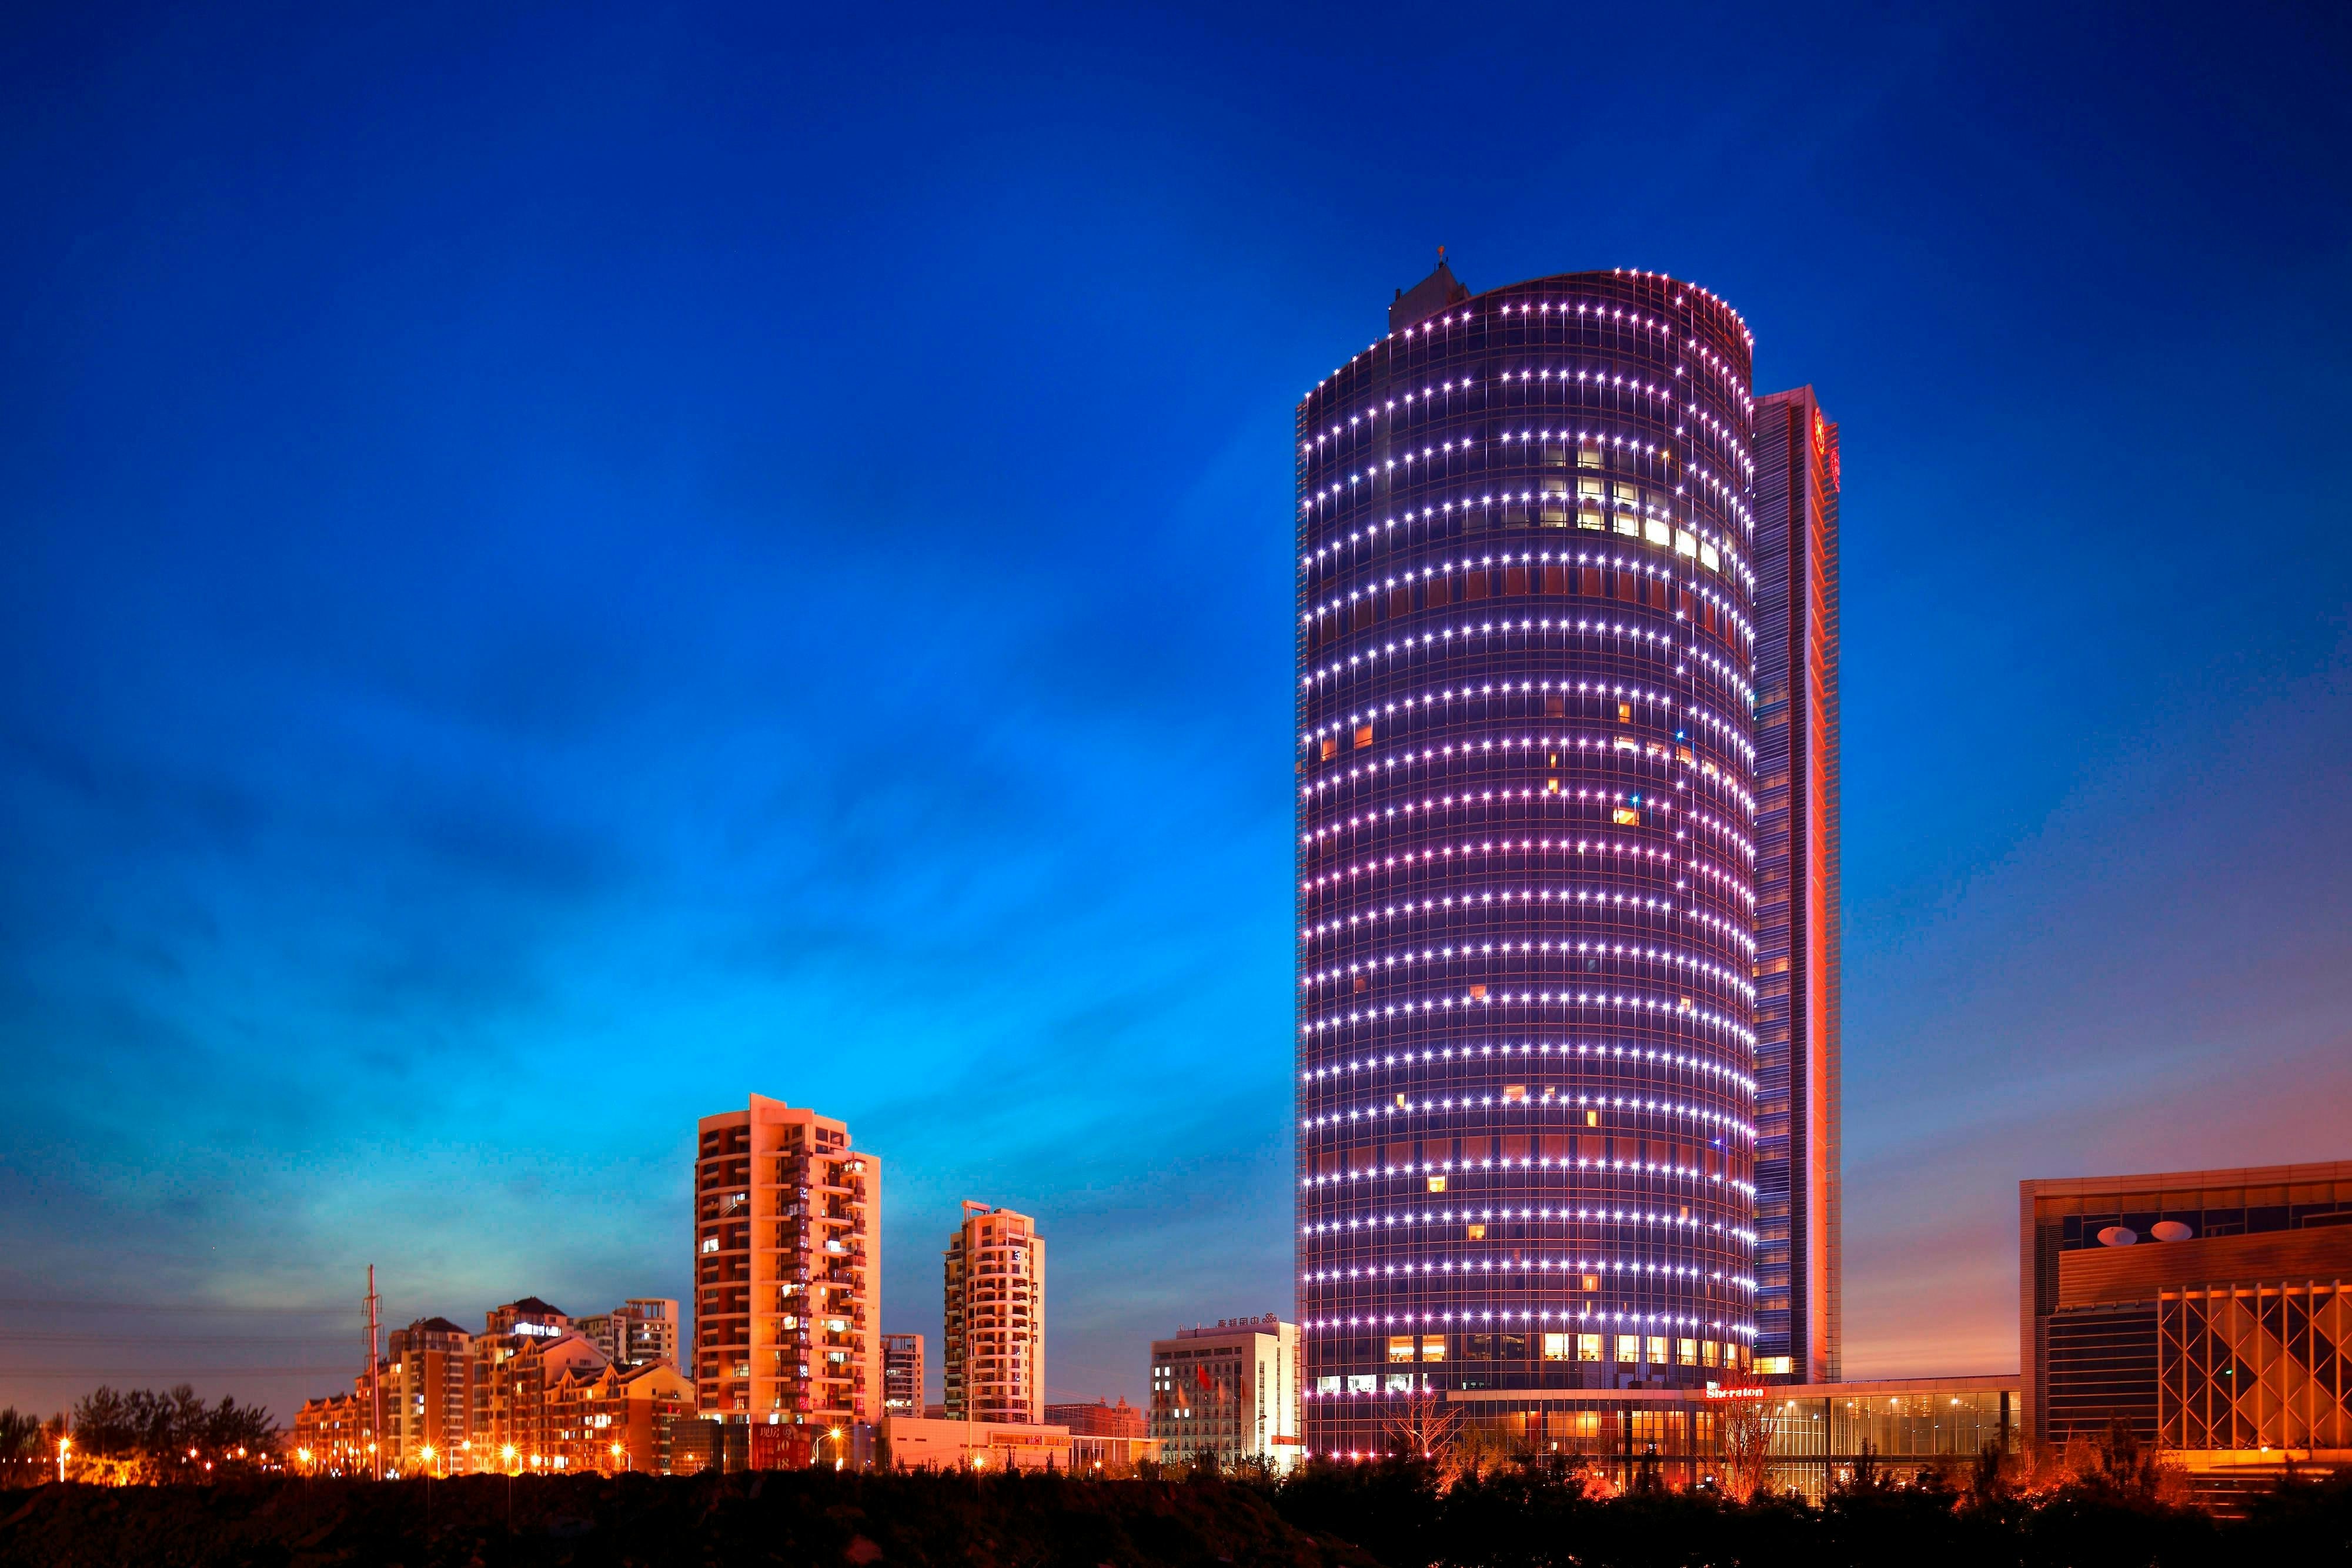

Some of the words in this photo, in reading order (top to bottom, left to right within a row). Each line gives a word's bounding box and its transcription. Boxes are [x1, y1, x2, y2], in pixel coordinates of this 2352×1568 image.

[1706, 1388, 1763, 1399] Sheraton
[776, 1439, 790, 1452] 10
[776, 1457, 790, 1470] 18
